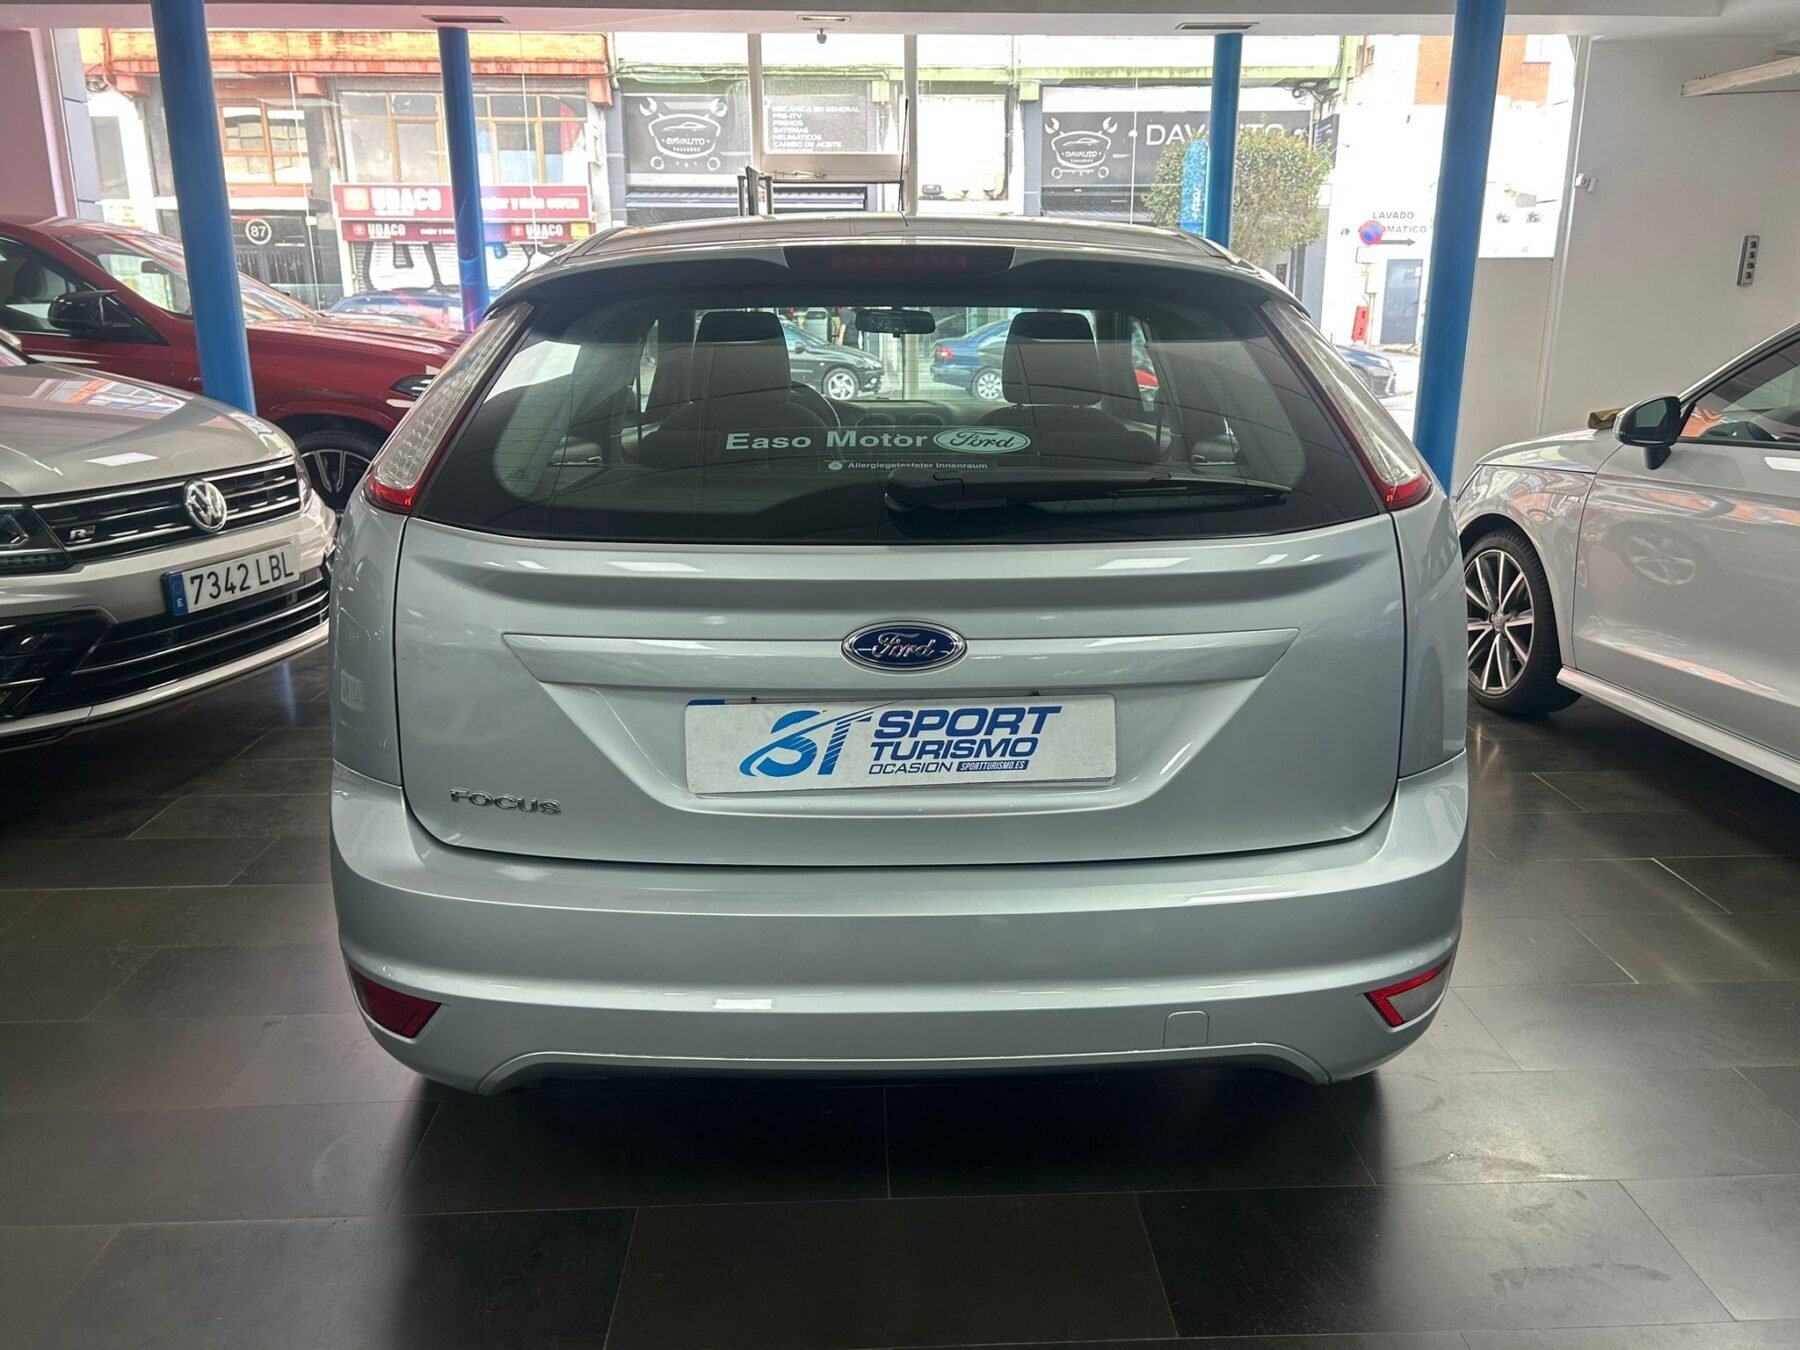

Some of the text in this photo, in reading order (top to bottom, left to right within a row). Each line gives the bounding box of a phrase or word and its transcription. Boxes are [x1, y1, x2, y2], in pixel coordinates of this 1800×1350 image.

[666, 137, 705, 145] DAVAUTO
[1146, 124, 1286, 145] DAVT
[1065, 150, 1098, 158] DAVAUTO
[1372, 211, 1415, 219] LAVADO
[250, 225, 266, 237] 87
[1358, 225, 1427, 233] MATICO
[726, 430, 1016, 450] Easo Motor Ford
[190, 551, 294, 605] 7342 LBL
[871, 631, 938, 658] Ford
[873, 706, 1062, 739] SPORT
[870, 737, 1039, 761] TURISMO
[868, 761, 953, 775] OCASION
[960, 760, 1026, 771] SPORTTURISMO.ES
[450, 787, 561, 815] FOCUS
